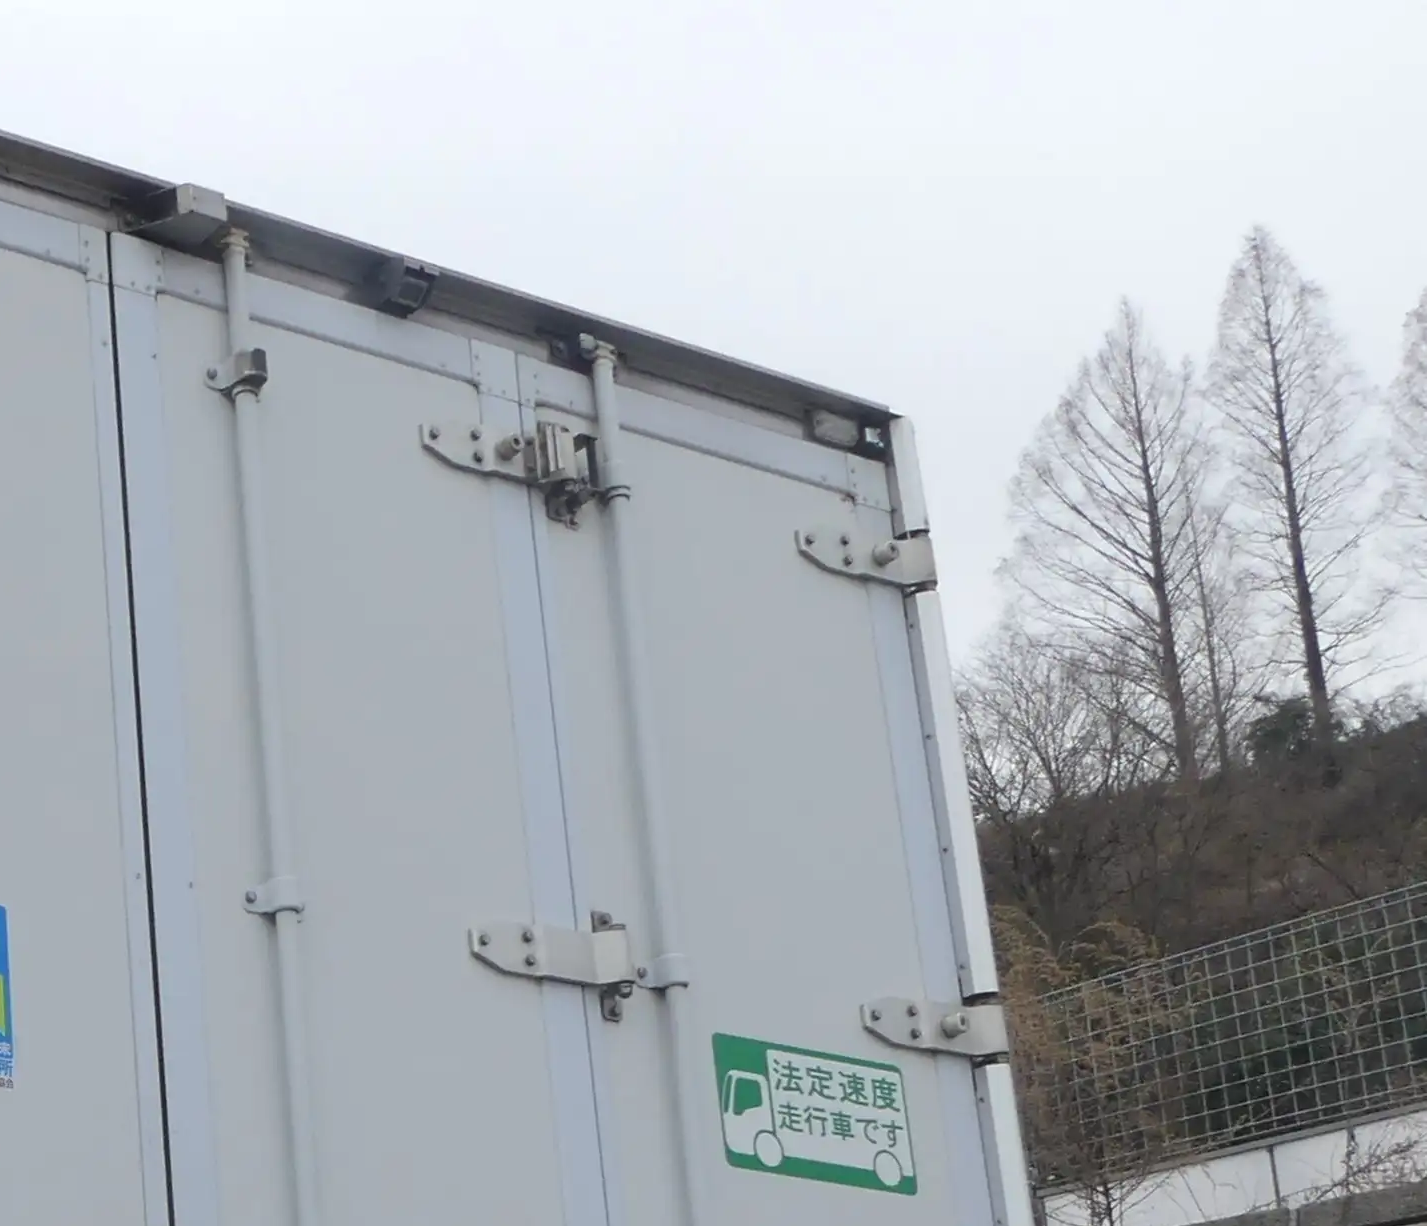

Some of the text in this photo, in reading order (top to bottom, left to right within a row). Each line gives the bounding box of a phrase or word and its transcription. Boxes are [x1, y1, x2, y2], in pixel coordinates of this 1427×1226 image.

[773, 1057, 901, 1113] 法定速度
[776, 1101, 904, 1149] 走行車です
